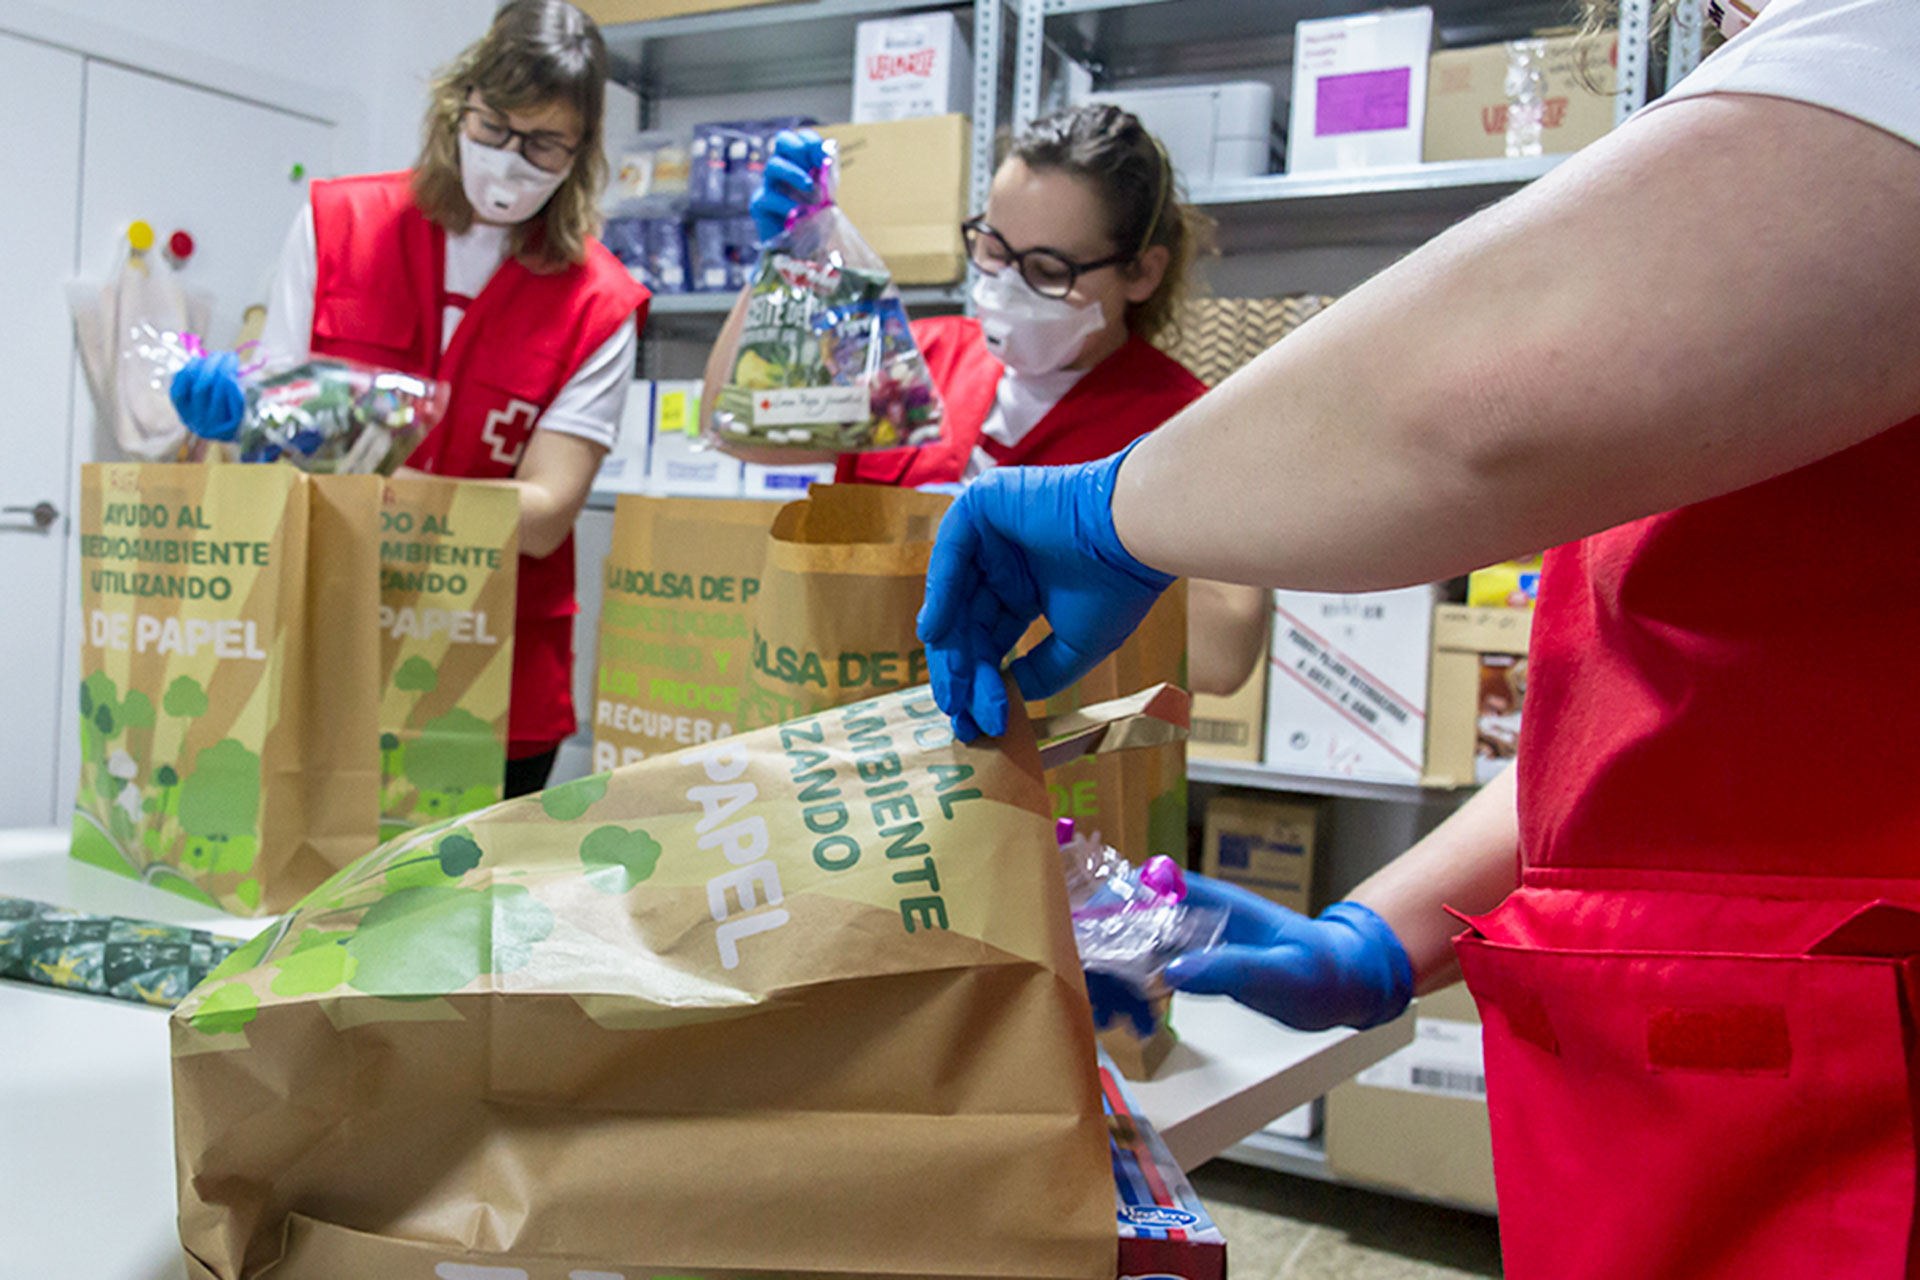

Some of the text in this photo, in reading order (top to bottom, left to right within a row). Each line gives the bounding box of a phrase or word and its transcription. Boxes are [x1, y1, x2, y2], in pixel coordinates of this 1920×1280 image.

[104, 504, 212, 530] AYUDO AL
[420, 514, 455, 536] AL
[90, 570, 233, 601] UTILIZANDO
[623, 568, 694, 600] BOLSA
[701, 575, 736, 603] DE
[741, 577, 760, 603] P
[91, 609, 129, 650] DE
[136, 614, 267, 660] PAPEL
[838, 651, 899, 689] DE
[650, 678, 740, 713] PROCE
[926, 764, 983, 821] AL
[678, 741, 790, 970] PAPEL
